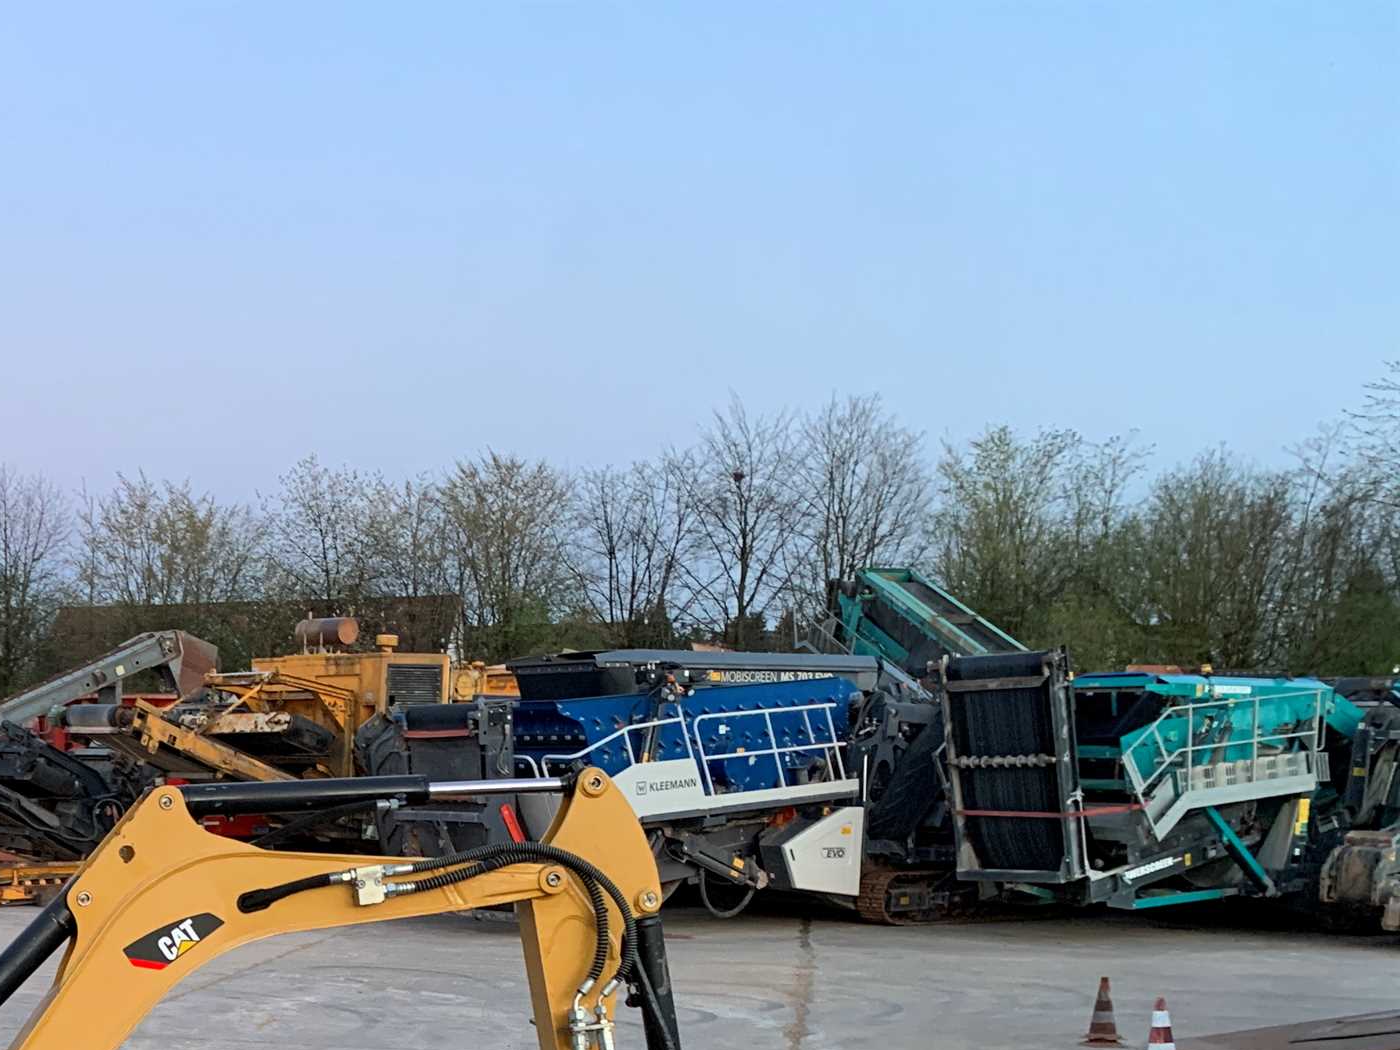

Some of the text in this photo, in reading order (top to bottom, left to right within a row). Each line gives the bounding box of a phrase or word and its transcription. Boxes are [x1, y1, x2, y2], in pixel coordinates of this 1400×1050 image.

[720, 671, 777, 682] MOBISCREEN
[781, 671, 795, 681] MS
[649, 778, 697, 792] KLEEMANN
[827, 849, 846, 858] EVO
[157, 918, 201, 961] CAT
